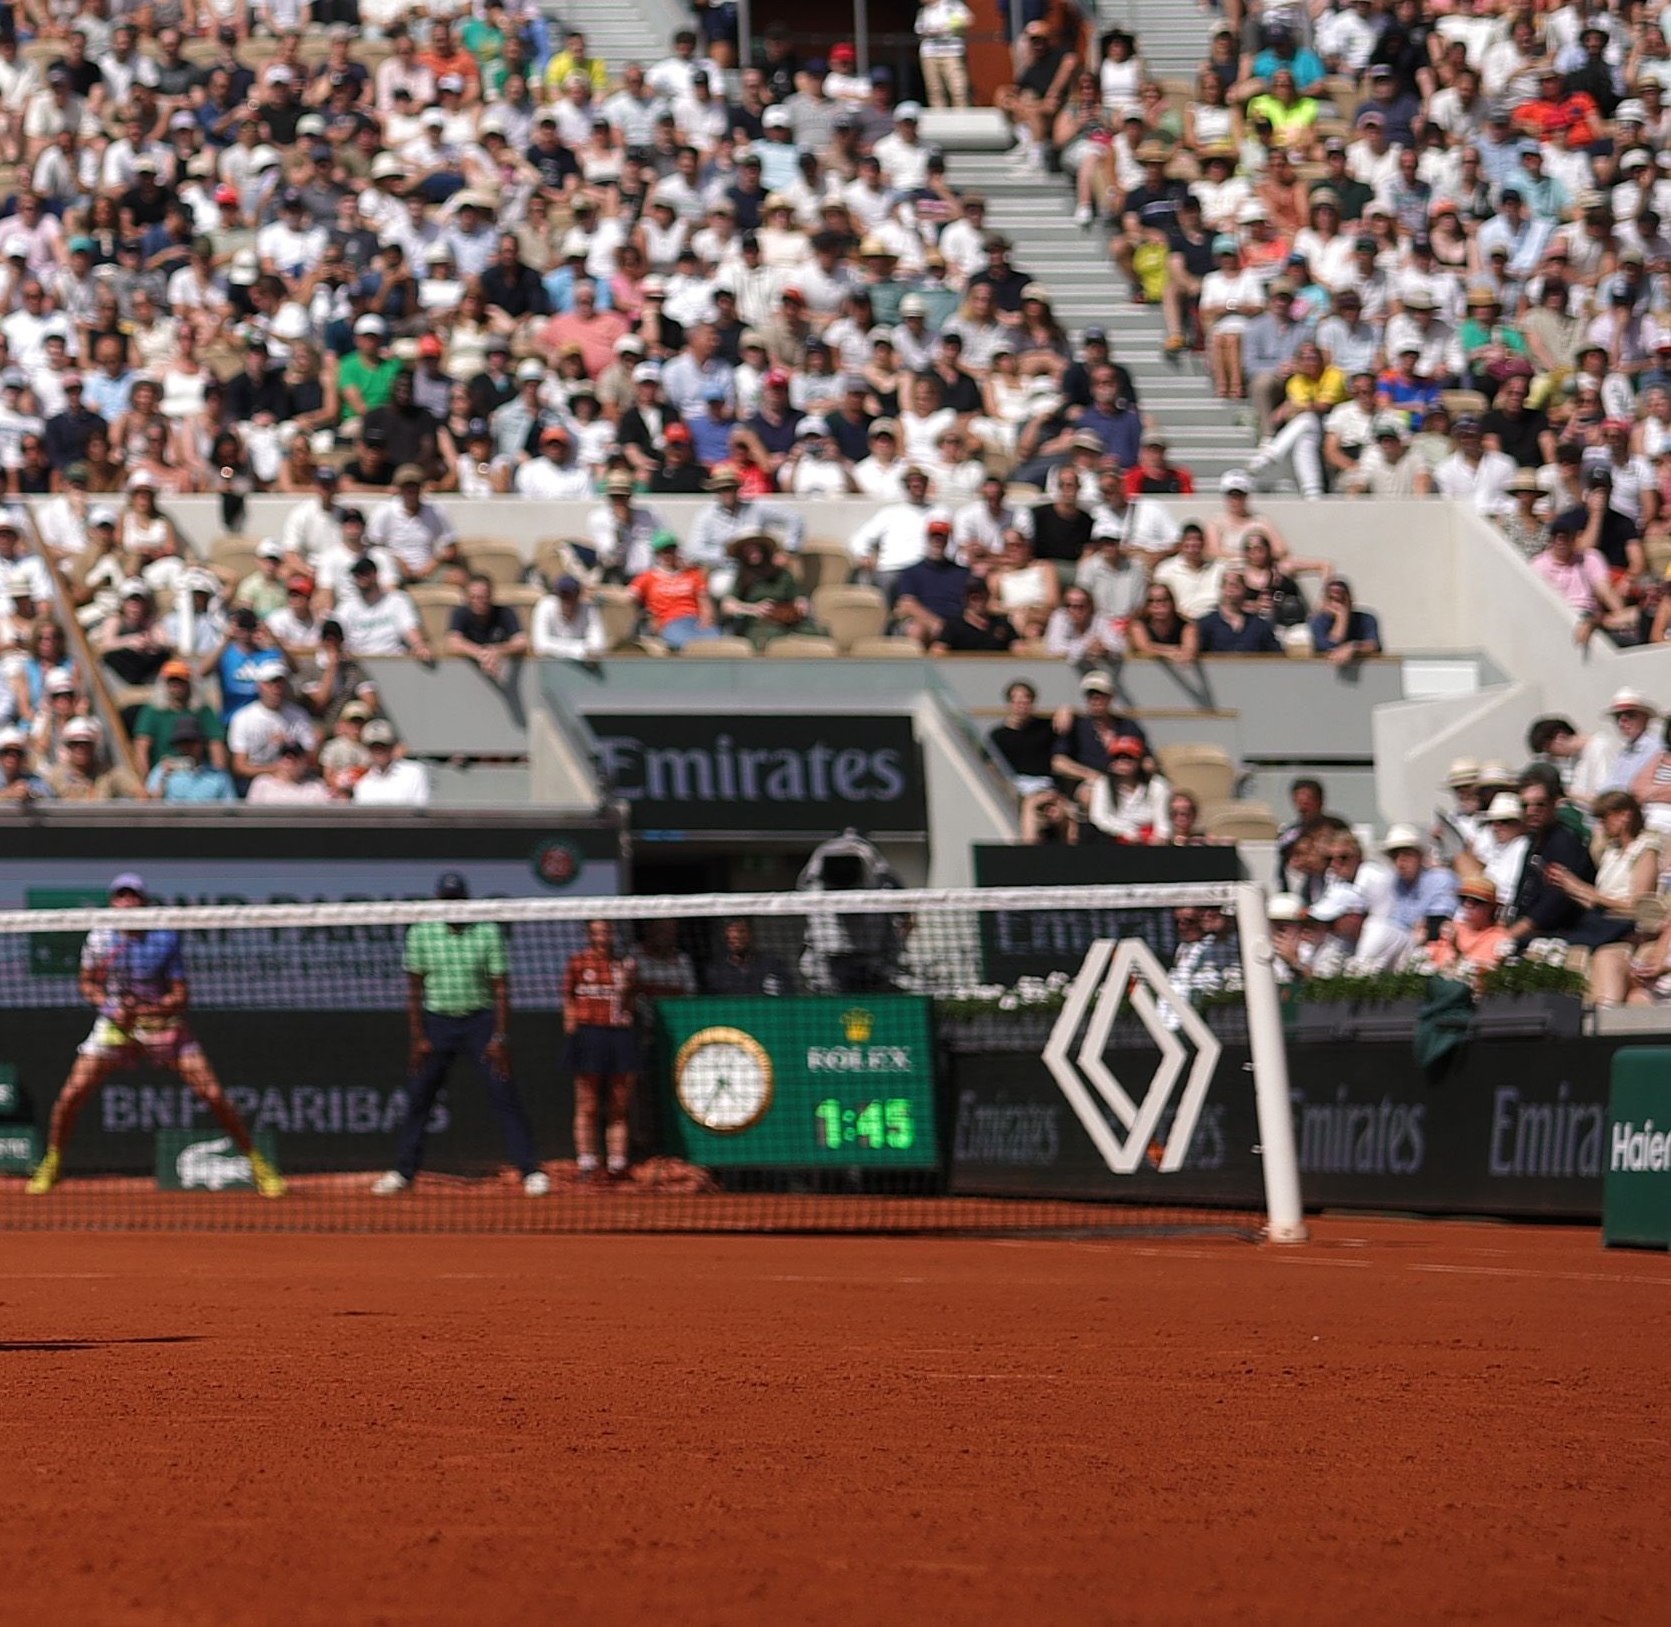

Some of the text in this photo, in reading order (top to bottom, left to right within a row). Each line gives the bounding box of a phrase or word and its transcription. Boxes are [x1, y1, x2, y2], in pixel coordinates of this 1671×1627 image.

[596, 733, 904, 802] Emirates
[807, 1045, 911, 1073] ROLEX
[815, 1098, 915, 1149] 1:45
[1488, 1081, 1606, 1177] Emira
